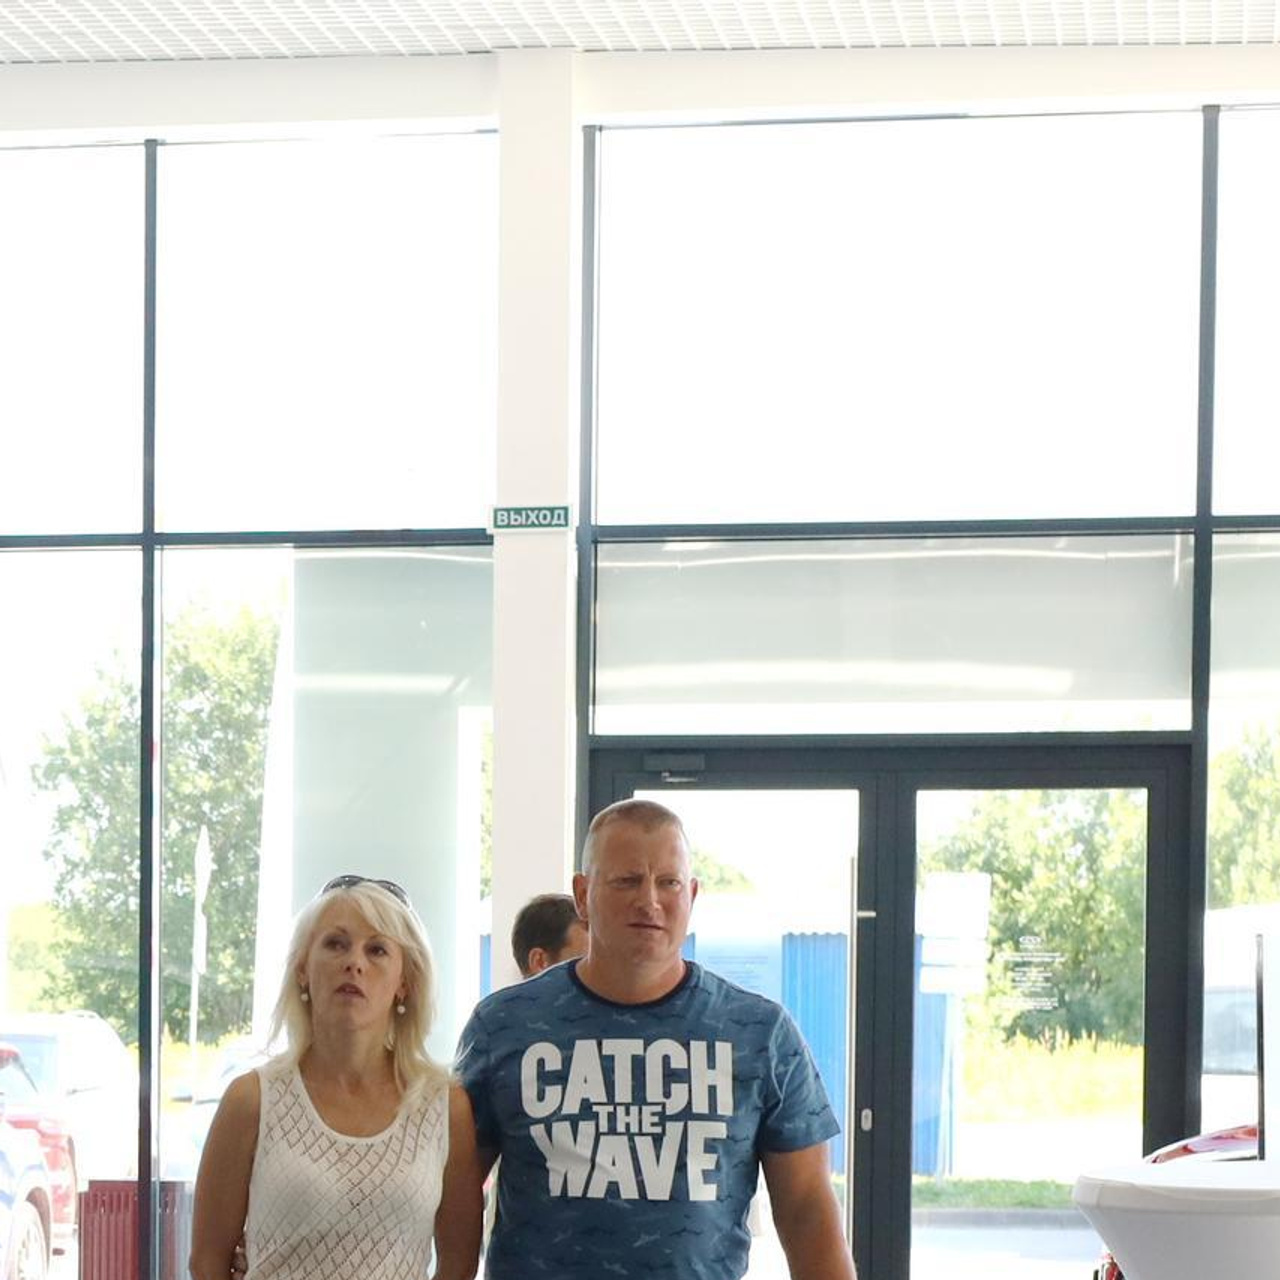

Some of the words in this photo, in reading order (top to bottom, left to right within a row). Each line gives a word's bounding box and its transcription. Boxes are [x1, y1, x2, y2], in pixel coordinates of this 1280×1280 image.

[496, 509, 566, 526] ВЫХОД
[521, 1039, 734, 1118] CATCH
[592, 1104, 663, 1134] THE
[530, 1120, 727, 1202] WAVE
